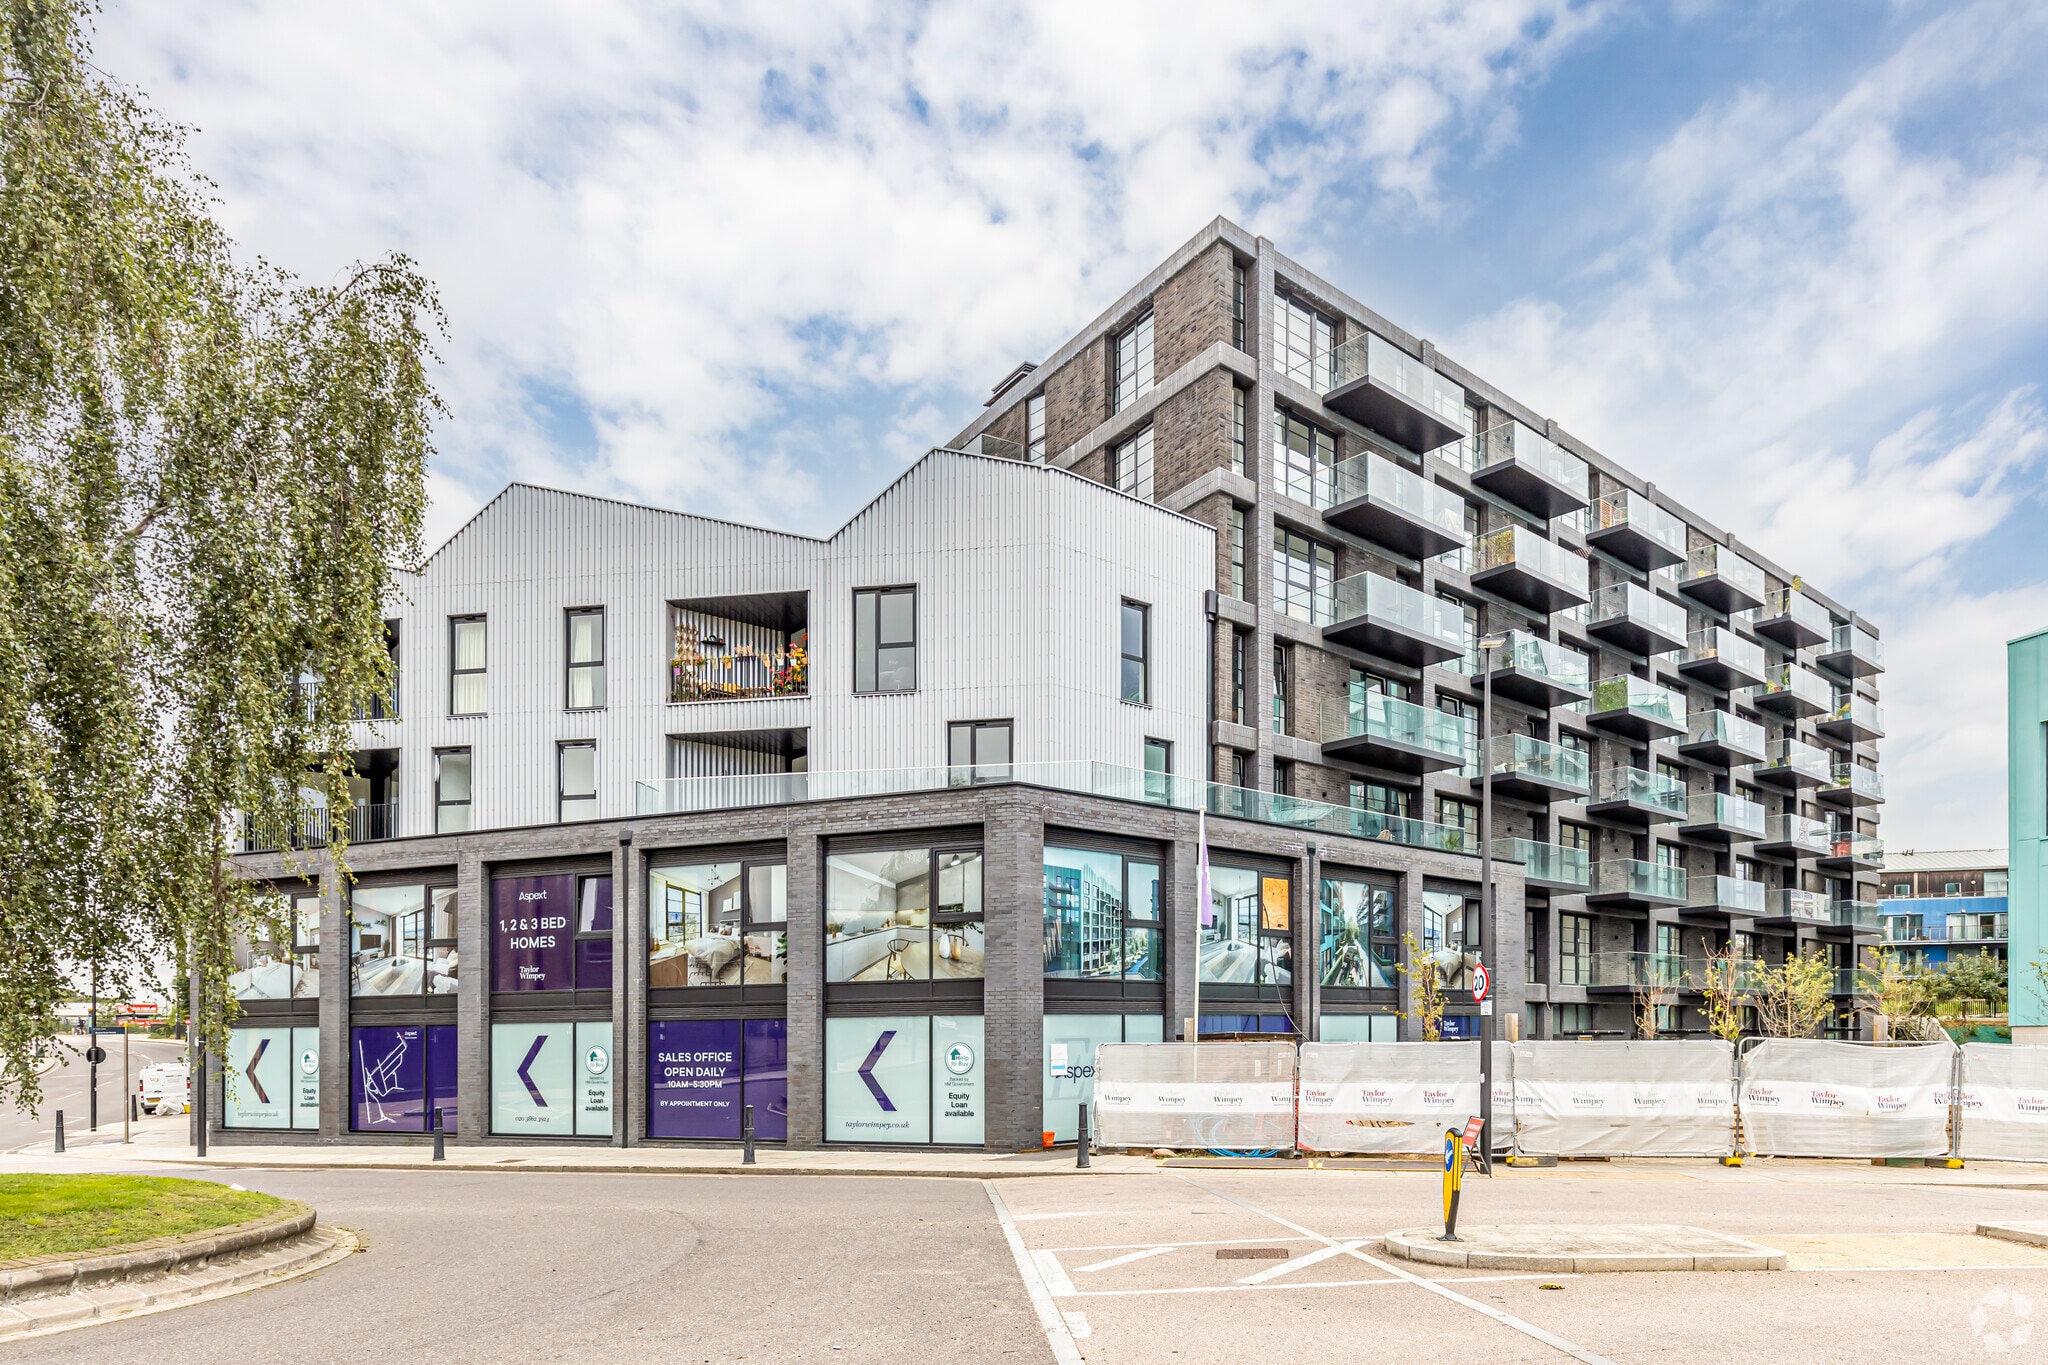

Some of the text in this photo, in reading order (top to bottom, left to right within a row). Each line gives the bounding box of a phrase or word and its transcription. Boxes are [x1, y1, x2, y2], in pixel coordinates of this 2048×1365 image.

[519, 890, 547, 902] Aspext
[500, 917, 566, 932] 1, 2 & 3 BED
[510, 936, 556, 949] HOMES
[520, 965, 540, 973] Taylor
[520, 972, 546, 981] Wimpey
[1474, 975, 1484, 991] 20
[658, 1052, 732, 1062] SALES OFFICE
[664, 1067, 726, 1076] OPEN DAILY
[1749, 1088, 1774, 1096] Taylor
[1811, 1090, 1838, 1099] Taylor
[1104, 1094, 1132, 1103] Wimpey
[1306, 1096, 1334, 1104] Wimpey
[1362, 1096, 1394, 1104] Wimpey
[1424, 1097, 1456, 1105] Wimpey
[1572, 1097, 1606, 1106] Wimpey
[1634, 1098, 1666, 1106] Wimpey
[1697, 1098, 1728, 1106] Wimpey
[1748, 1094, 1781, 1104] Wimpey
[1811, 1097, 1846, 1108] Wimpey
[1878, 1102, 1908, 1110] Wimpey
